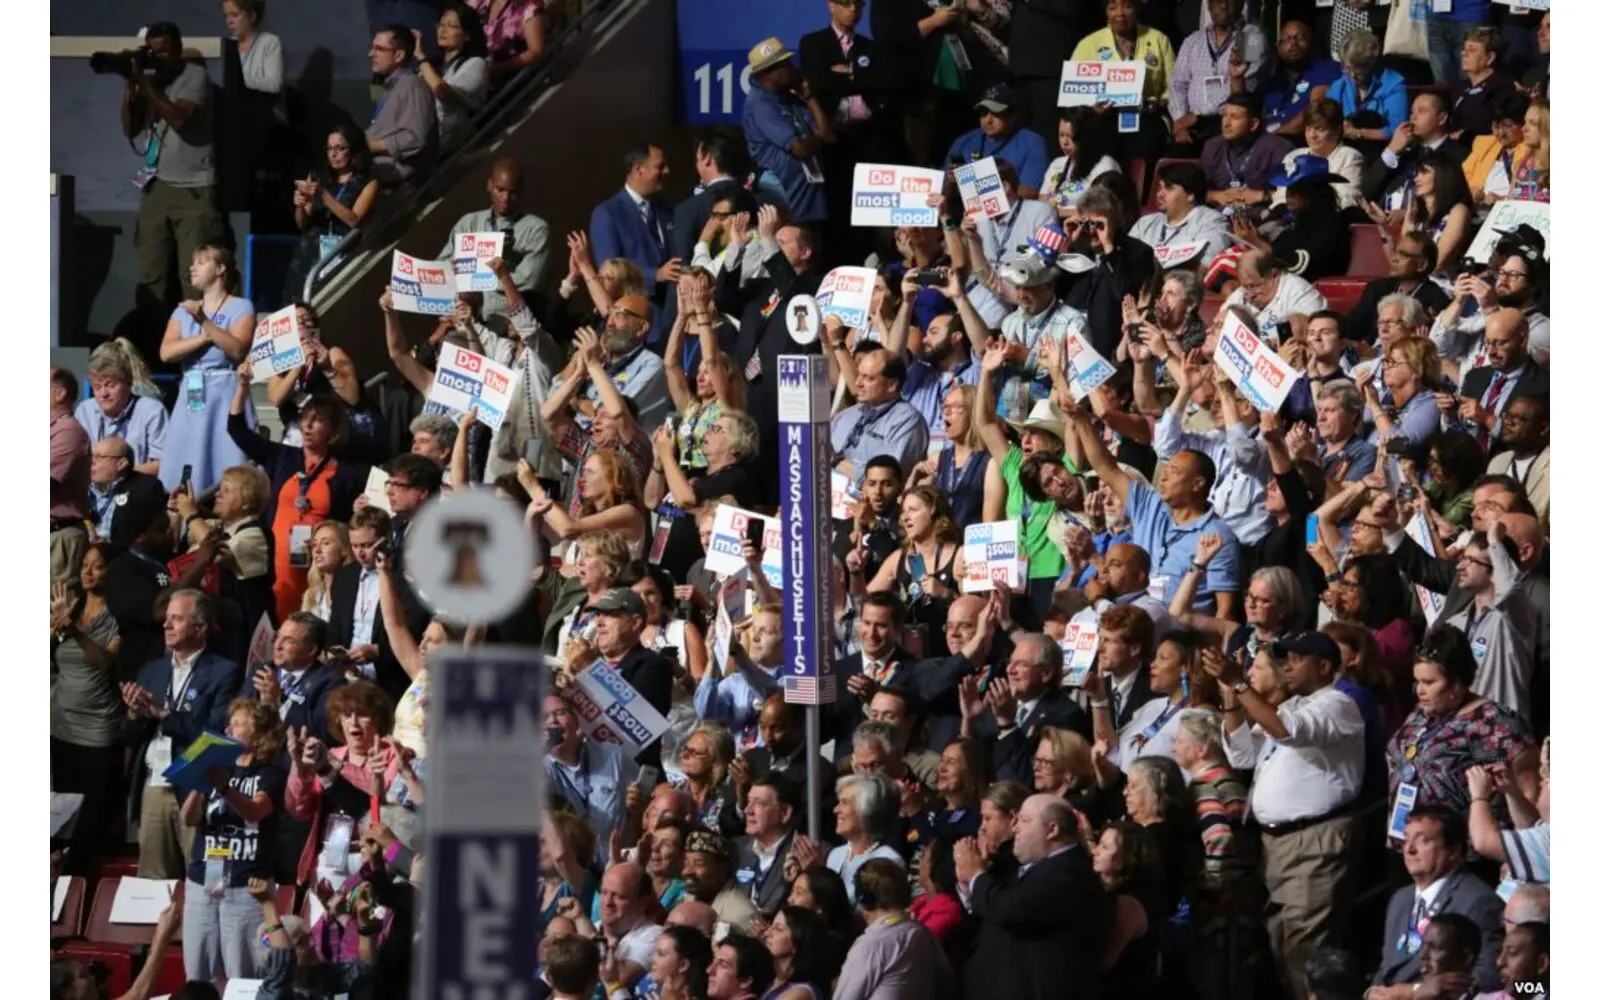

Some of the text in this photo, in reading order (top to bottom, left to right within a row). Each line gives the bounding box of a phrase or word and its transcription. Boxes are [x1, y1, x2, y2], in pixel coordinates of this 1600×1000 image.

[1079, 64, 1134, 82] Do the
[1064, 82, 1105, 94] most
[870, 171, 931, 193] Do the
[856, 193, 899, 208] most
[892, 208, 934, 224] good
[463, 236, 496, 257] Do the
[399, 256, 445, 285] Do the
[392, 277, 422, 296] most
[836, 276, 864, 292] the
[273, 319, 291, 336] the
[273, 348, 302, 372] good
[1221, 337, 1252, 378] most
[1235, 325, 1256, 353] Do
[1256, 355, 1283, 390] the
[457, 349, 507, 394] Do the
[440, 372, 481, 397] most
[472, 400, 502, 424] ood
[733, 512, 781, 549] D th
[714, 538, 741, 556] mo
[788, 425, 806, 674] MASSACHUSETTS
[987, 542, 1015, 560] most
[590, 662, 635, 702] good
[573, 691, 602, 720] the
[606, 702, 651, 744] most
